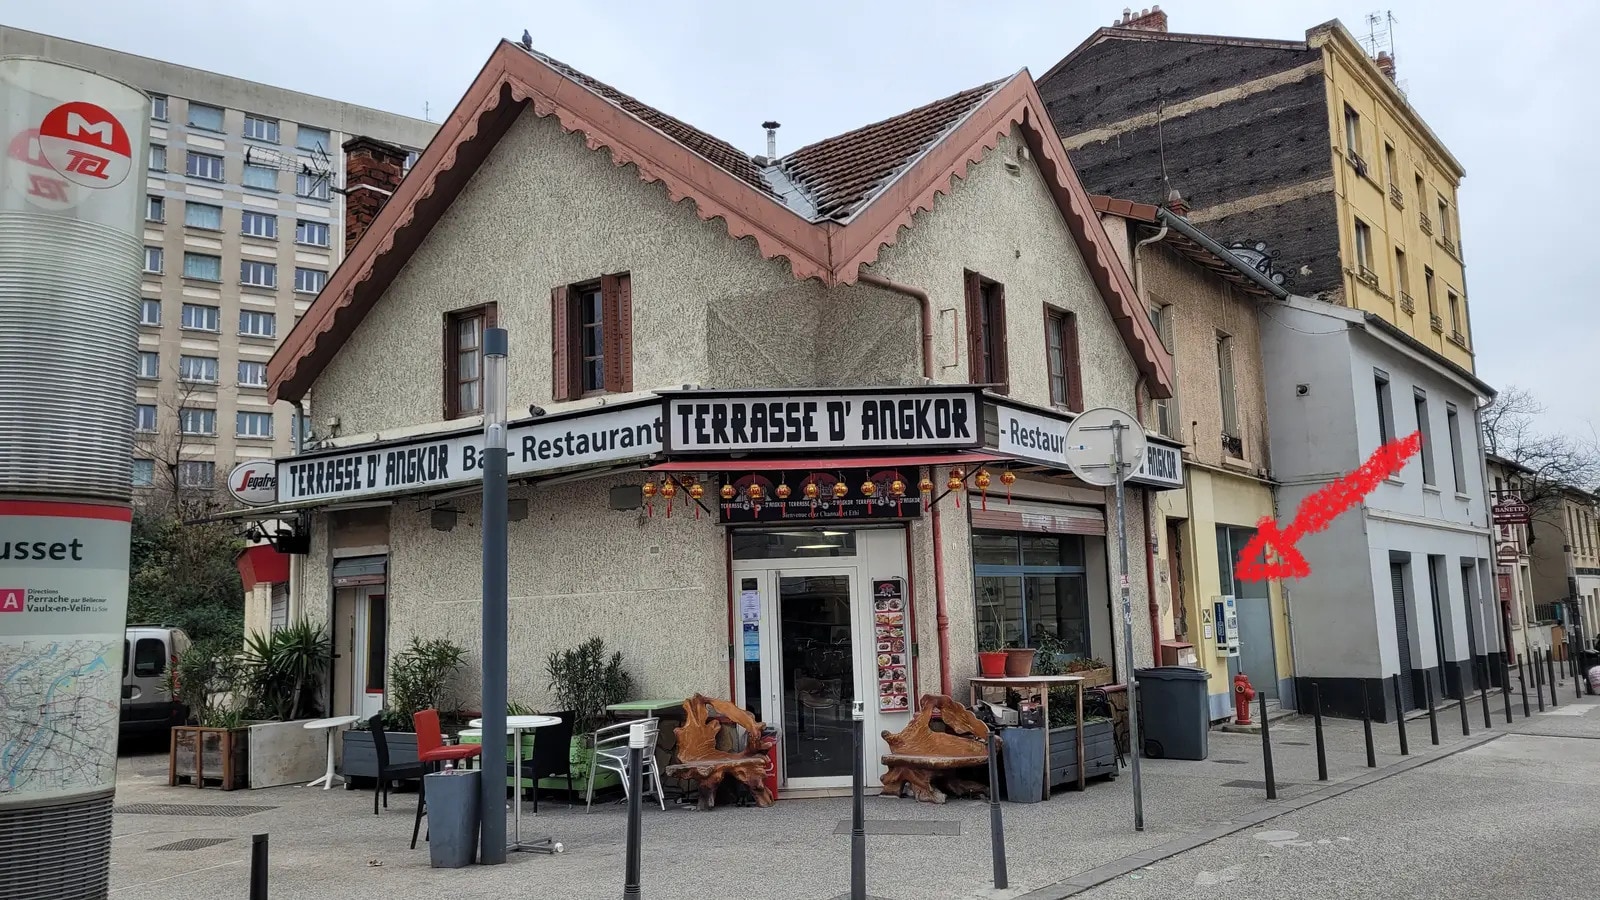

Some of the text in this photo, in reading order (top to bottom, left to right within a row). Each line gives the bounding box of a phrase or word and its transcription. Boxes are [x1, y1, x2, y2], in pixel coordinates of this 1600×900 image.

[66, 111, 113, 145] M
[65, 149, 111, 180] TCL
[677, 401, 818, 444] TERRASSE
[861, 398, 970, 439] ANGKOR
[1010, 418, 1065, 453] Restaur
[290, 456, 362, 497] TERRASSE
[385, 444, 449, 486] ANGKOR
[522, 416, 663, 462] Restaurant
[235, 469, 276, 492] Segafre
[3, 592, 18, 609] A
[27, 594, 69, 603] Perrache
[27, 604, 91, 612] Vaulx-en-Velin
